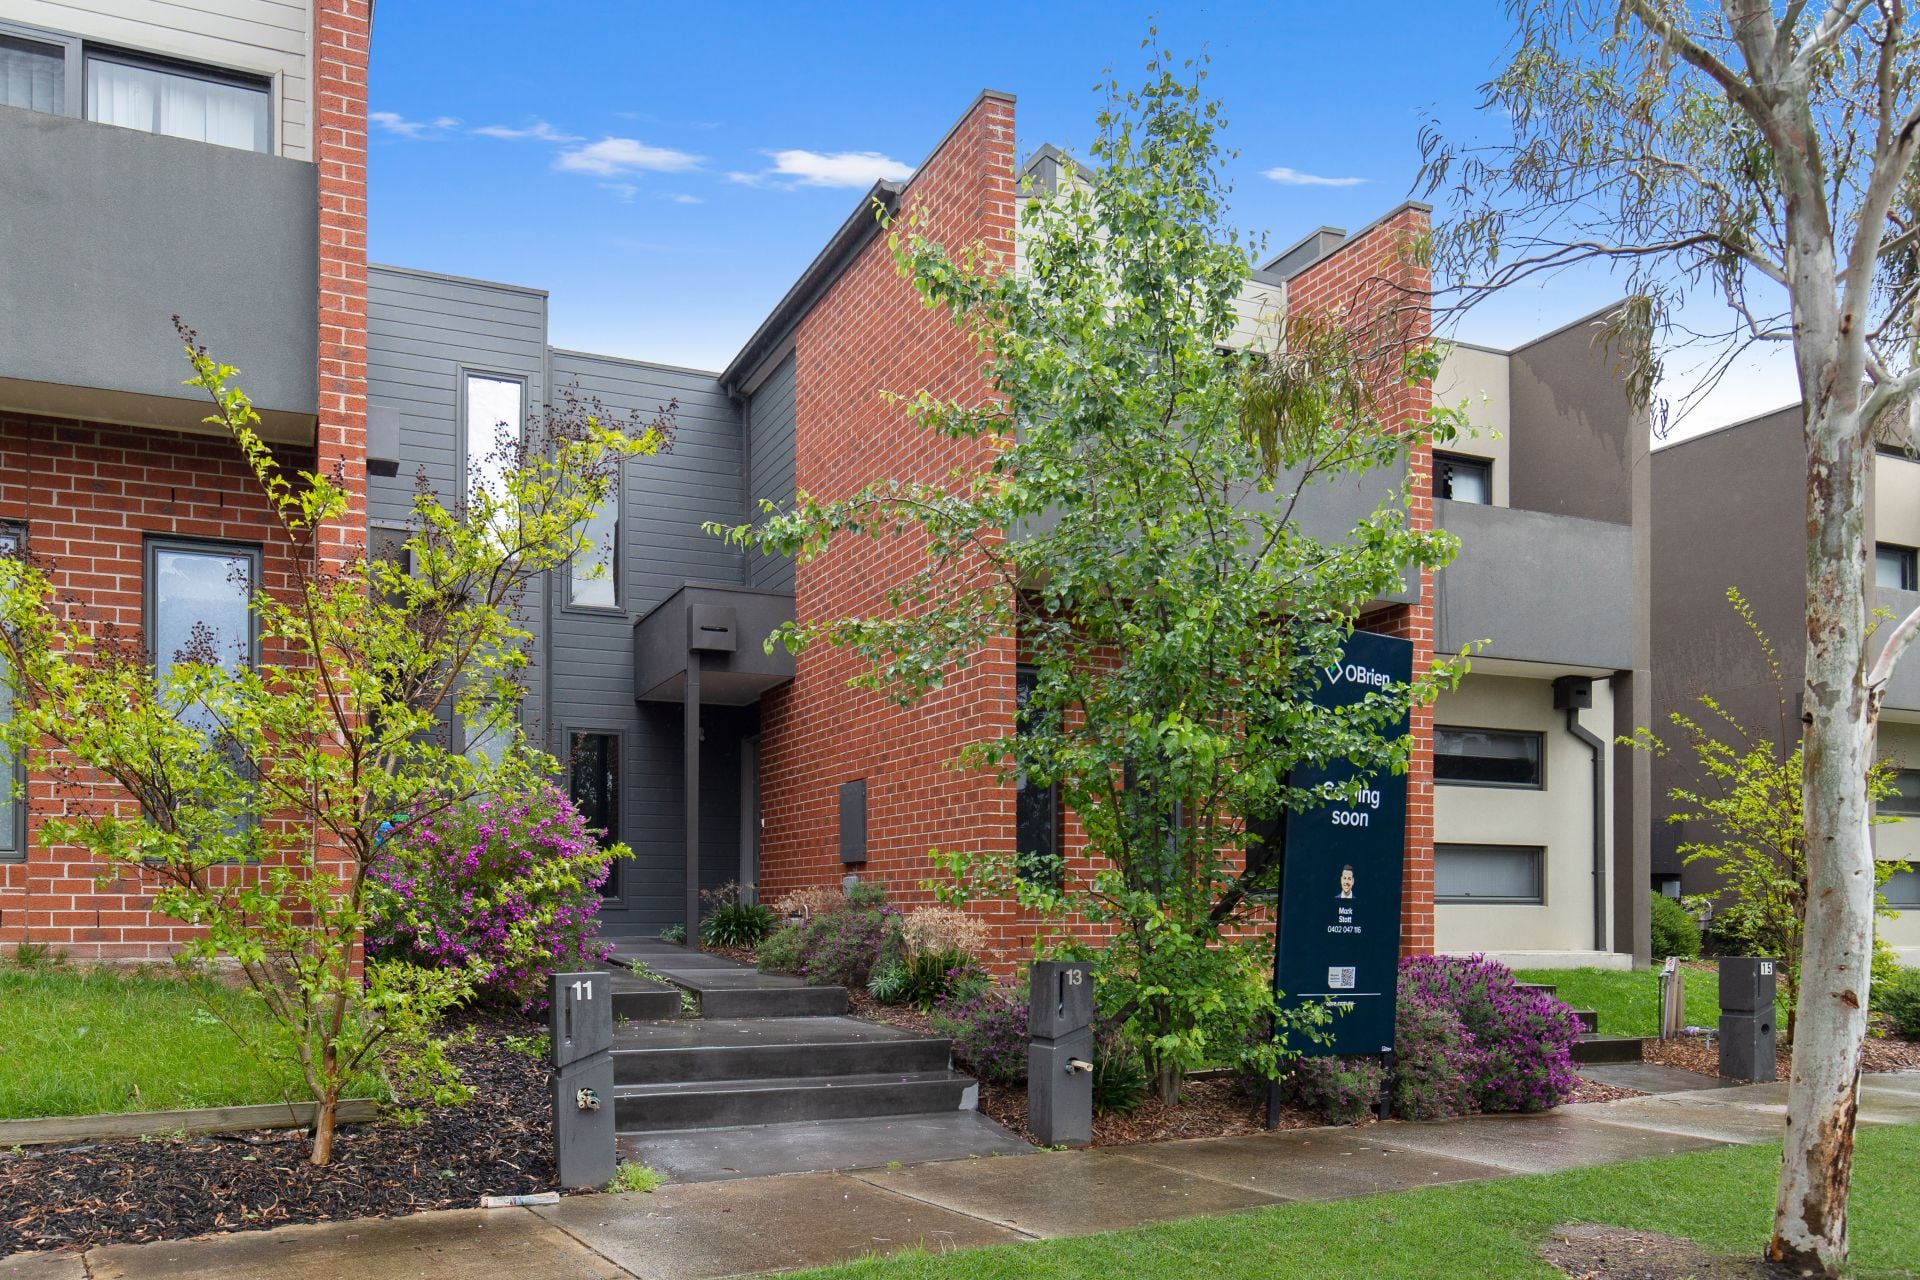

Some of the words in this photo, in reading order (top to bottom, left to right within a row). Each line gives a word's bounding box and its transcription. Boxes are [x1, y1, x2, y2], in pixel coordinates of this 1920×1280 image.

[1345, 664, 1390, 686] OBrien
[1331, 810, 1369, 827] soon
[1338, 907, 1353, 915] Mark
[1327, 925, 1342, 933] 0402
[1065, 968, 1083, 986] 13
[1762, 963, 1772, 974] 15
[571, 980, 593, 1001] 11
